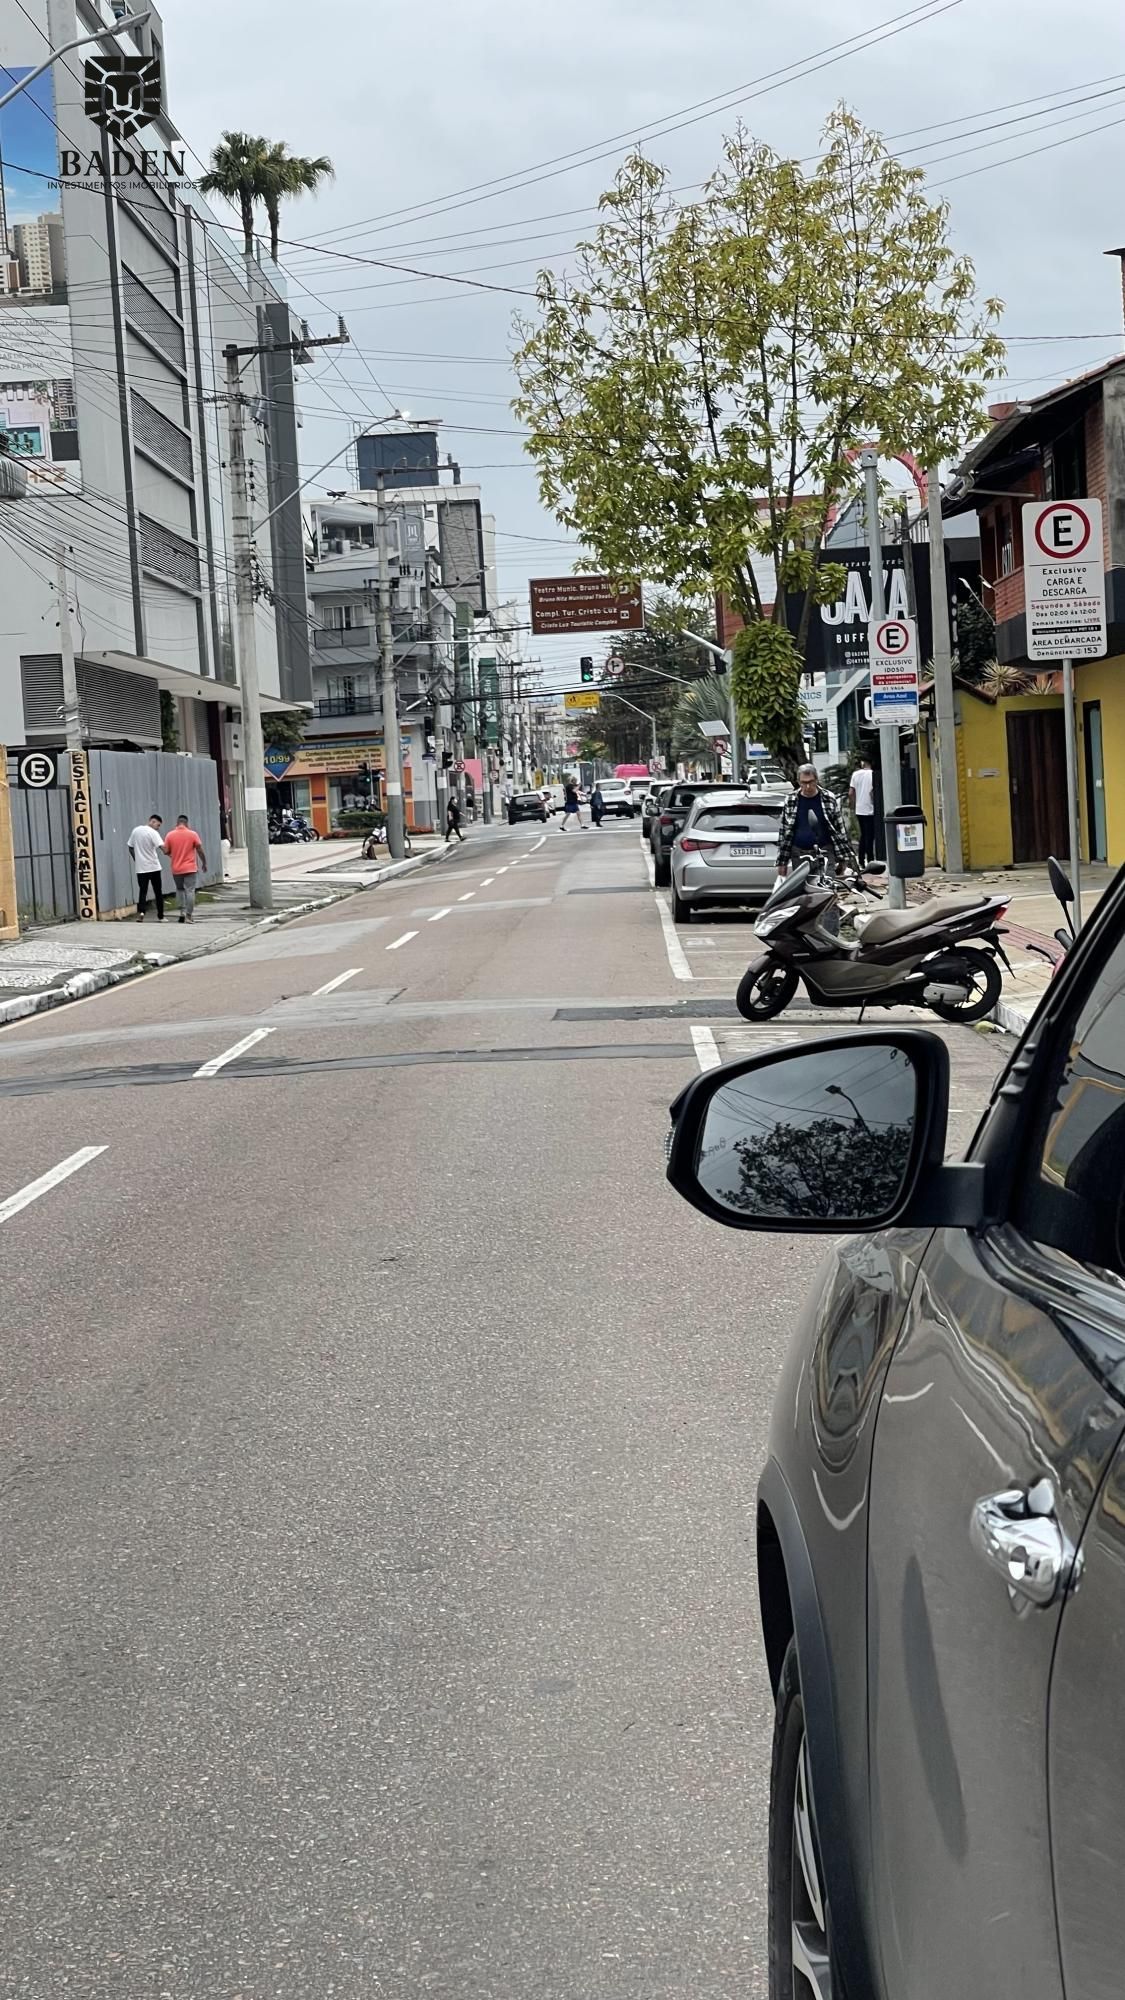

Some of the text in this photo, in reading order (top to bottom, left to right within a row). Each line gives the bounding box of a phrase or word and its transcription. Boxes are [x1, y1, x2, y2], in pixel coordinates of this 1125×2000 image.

[1053, 515, 1073, 547] E
[1042, 567, 1087, 575] Exclusivo
[1046, 577, 1076, 586] CARGA
[1042, 587, 1087, 597] DESCARGA
[1031, 602, 1063, 610] Segunda
[886, 628, 900, 648] E
[1054, 636, 1102, 645] DEMARCADA
[30, 760, 46, 780] E
[72, 754, 94, 919] ESTACIONAMENTO
